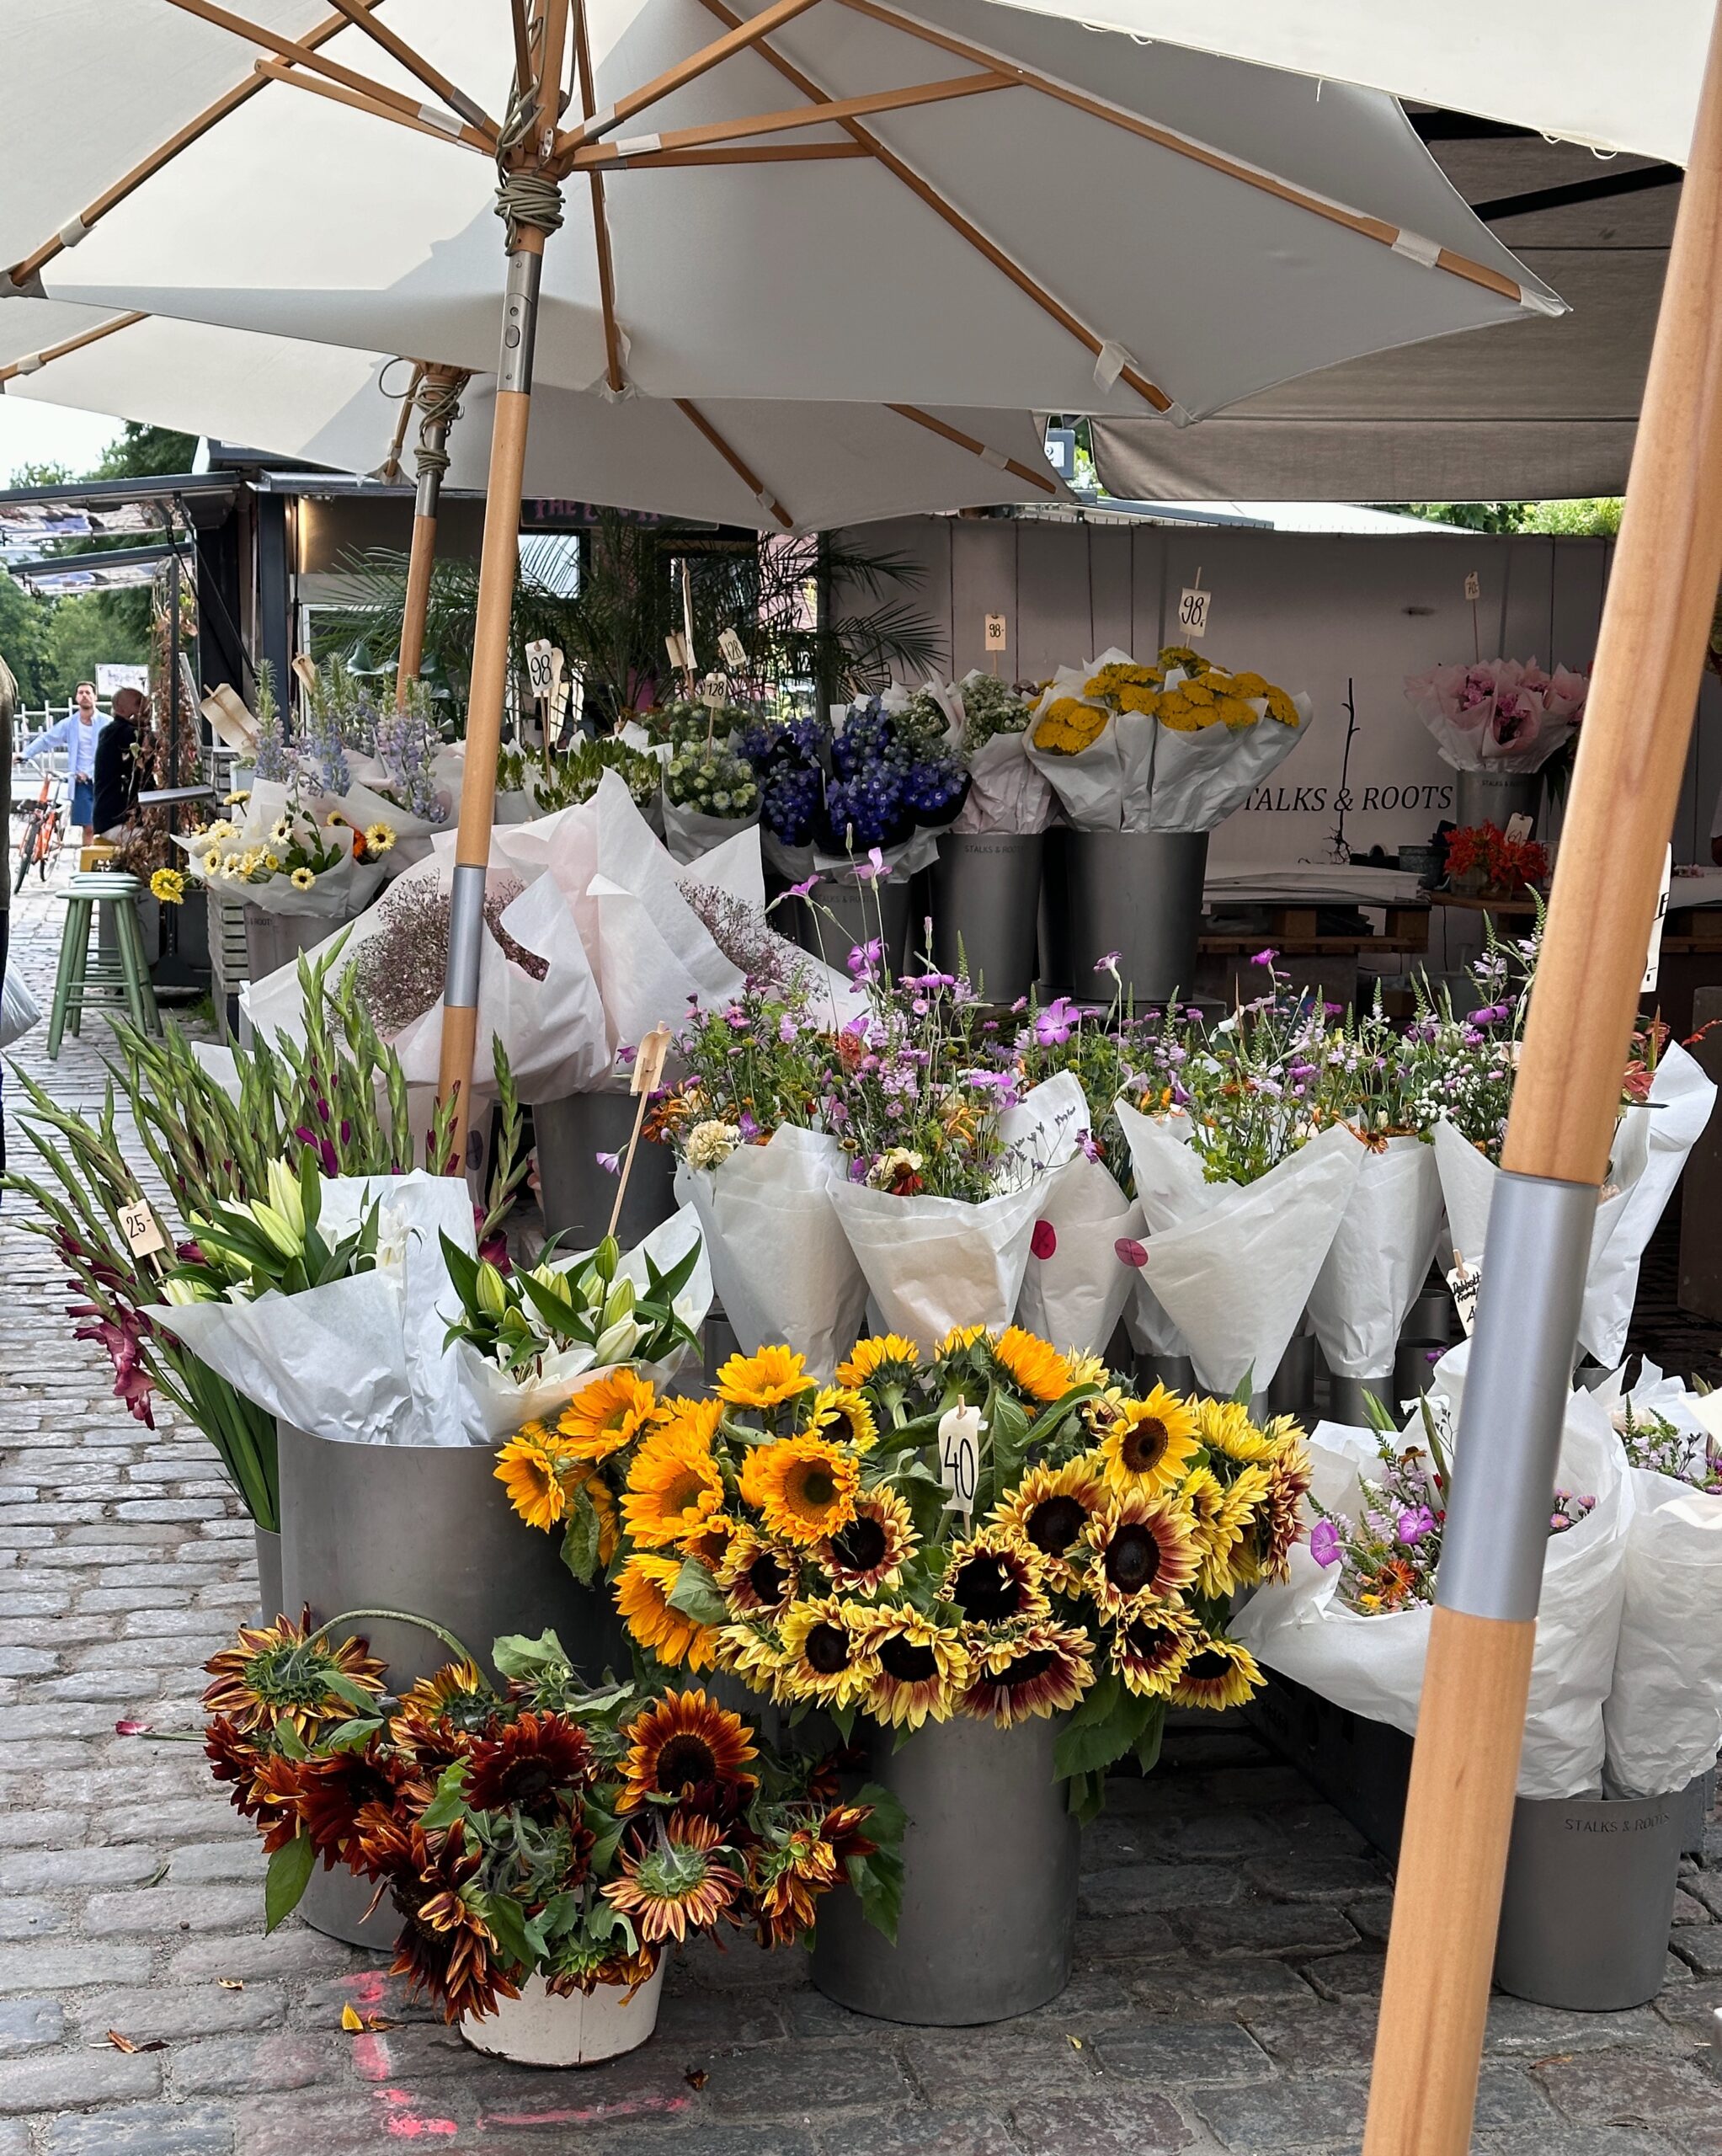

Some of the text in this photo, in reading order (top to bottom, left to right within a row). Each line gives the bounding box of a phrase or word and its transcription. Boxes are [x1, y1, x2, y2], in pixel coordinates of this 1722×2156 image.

[1245, 786, 1453, 812] TALKS & ROOTS
[944, 1435, 975, 1500] 40
[1565, 1818, 1618, 1833] STALKS
[1622, 1820, 1631, 1833] &
